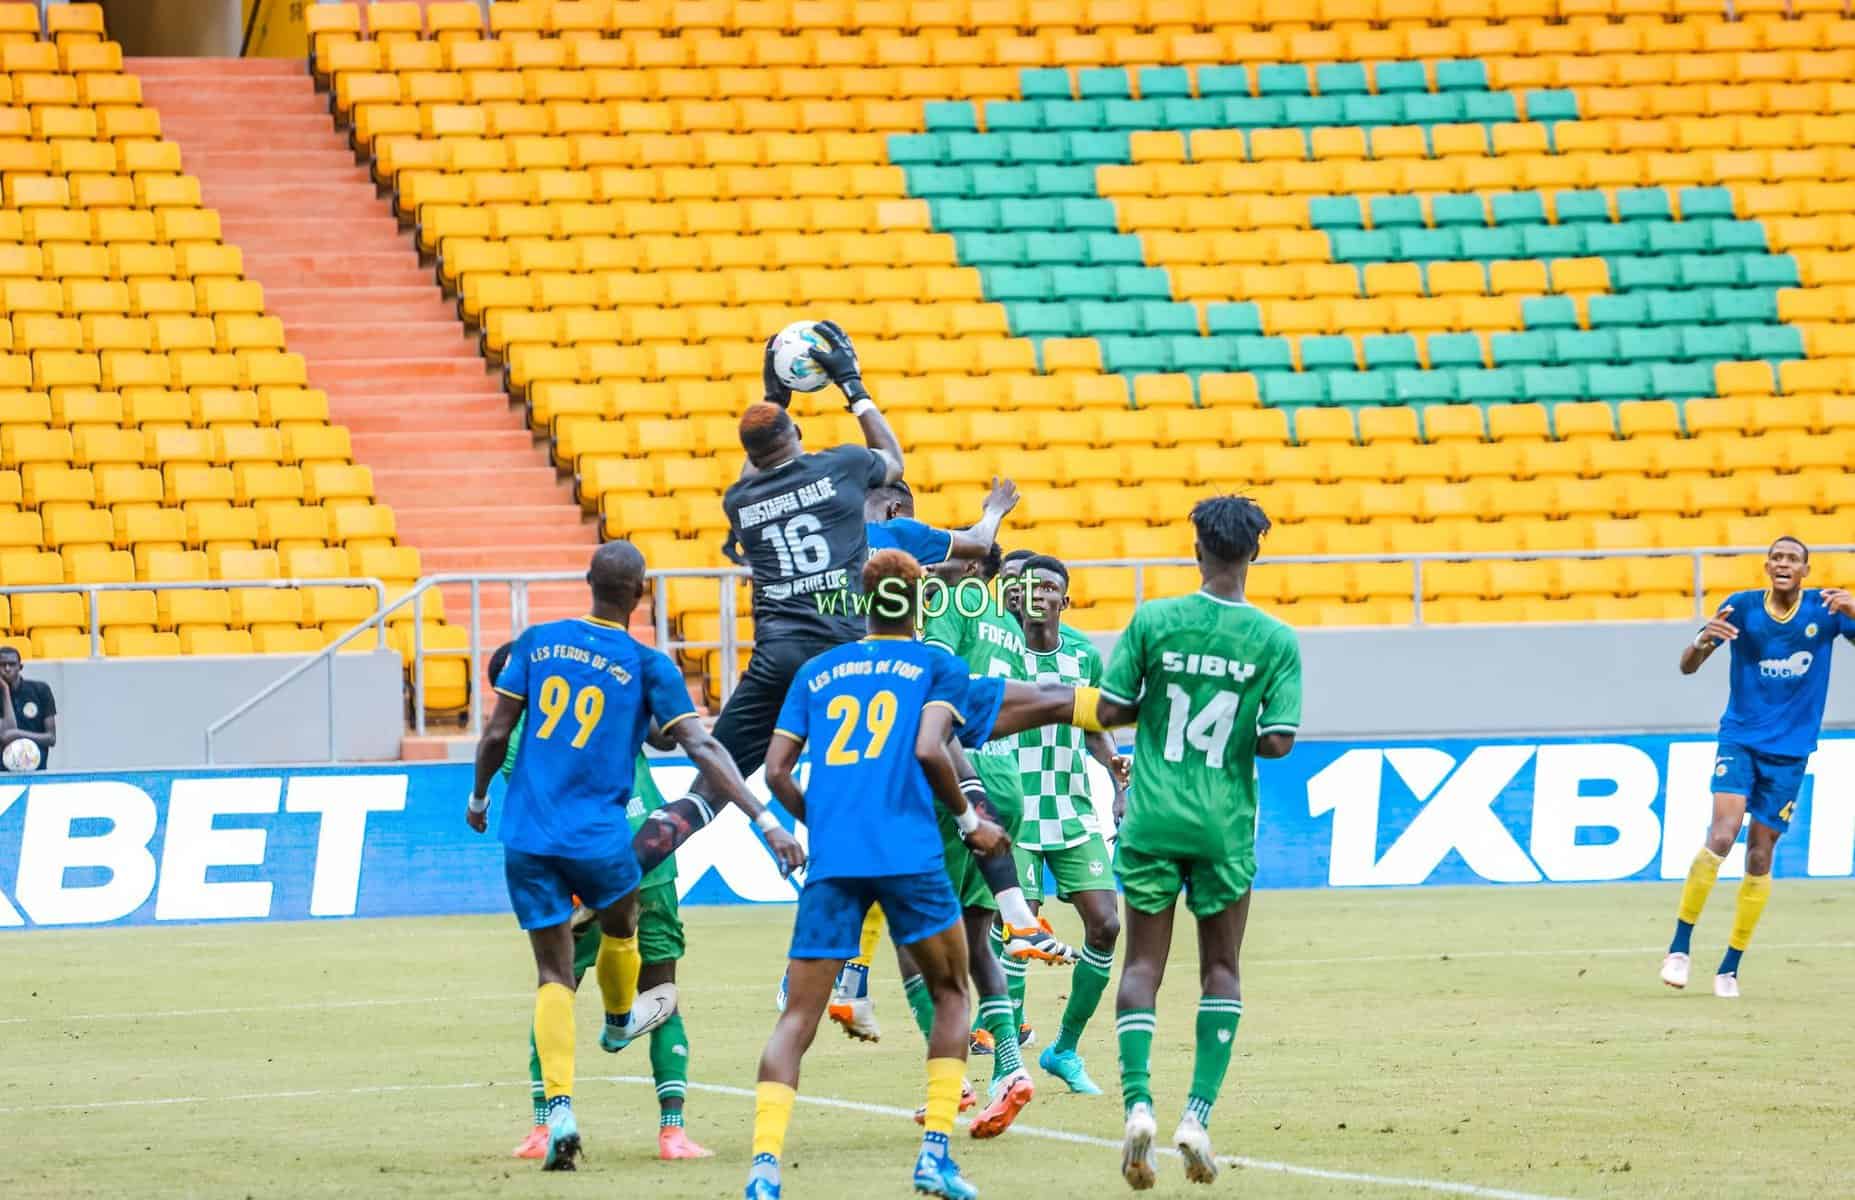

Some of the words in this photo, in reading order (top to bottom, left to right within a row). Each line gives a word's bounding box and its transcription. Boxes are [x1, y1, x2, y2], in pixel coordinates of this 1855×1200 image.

[761, 513, 831, 577] 16
[530, 645, 551, 664] LES
[807, 670, 832, 693] LES
[1161, 651, 1257, 683] SIBY
[535, 674, 606, 750] 99
[825, 689, 899, 767] 29
[1163, 682, 1240, 770] 14
[0, 774, 409, 928] BET
[1026, 862, 1037, 887] 4
